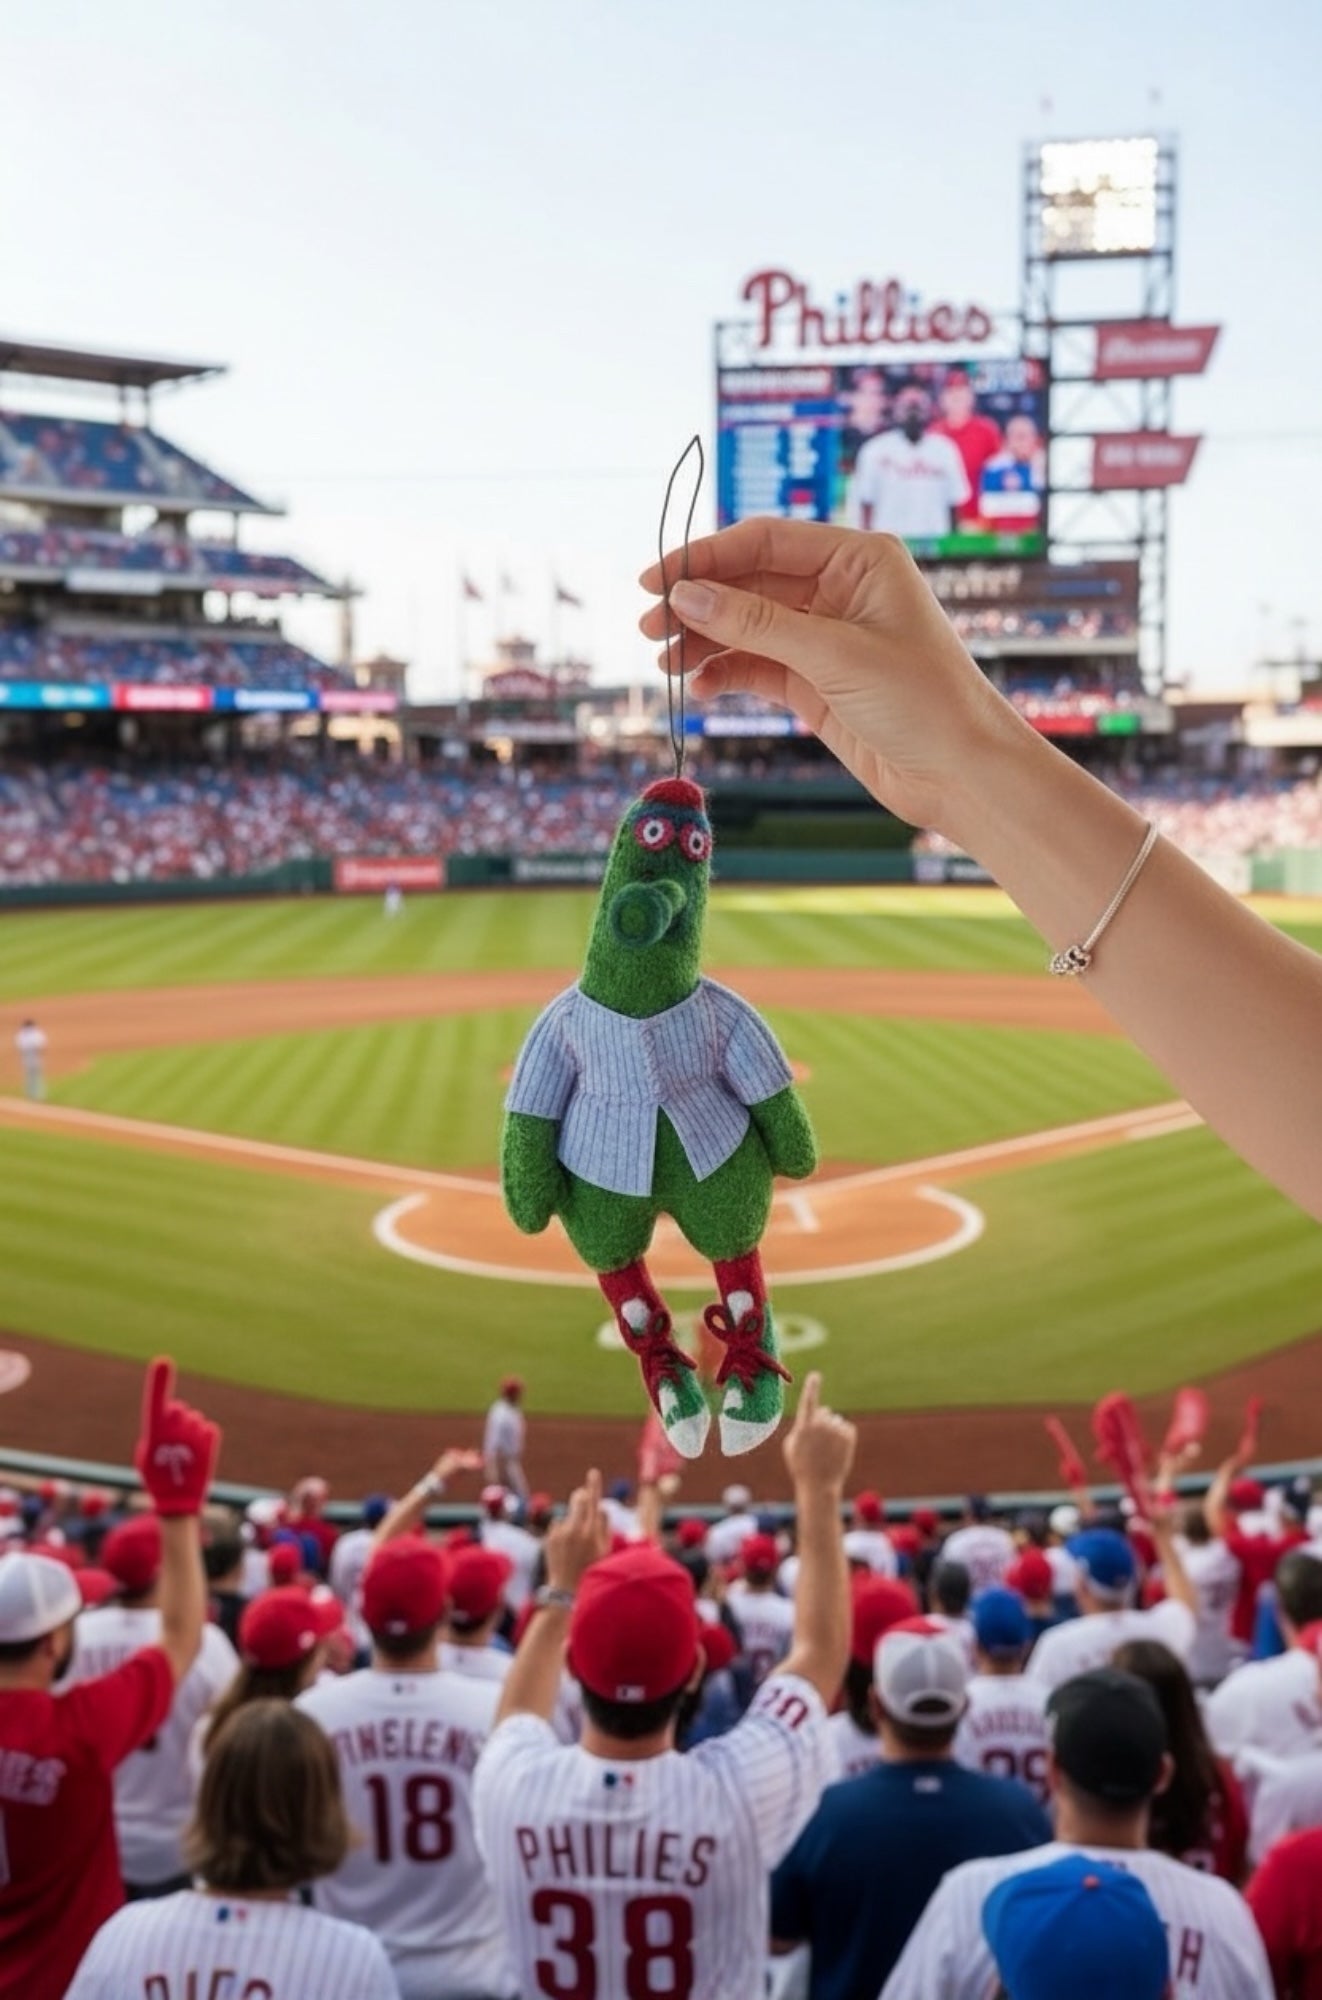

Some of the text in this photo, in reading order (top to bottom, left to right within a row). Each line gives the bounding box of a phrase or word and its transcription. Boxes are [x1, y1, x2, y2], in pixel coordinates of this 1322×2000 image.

[743, 270, 992, 347] Phillies
[366, 1772, 454, 1865] 18
[516, 1823, 716, 1887] PHILIES
[532, 1886, 696, 2000] 38
